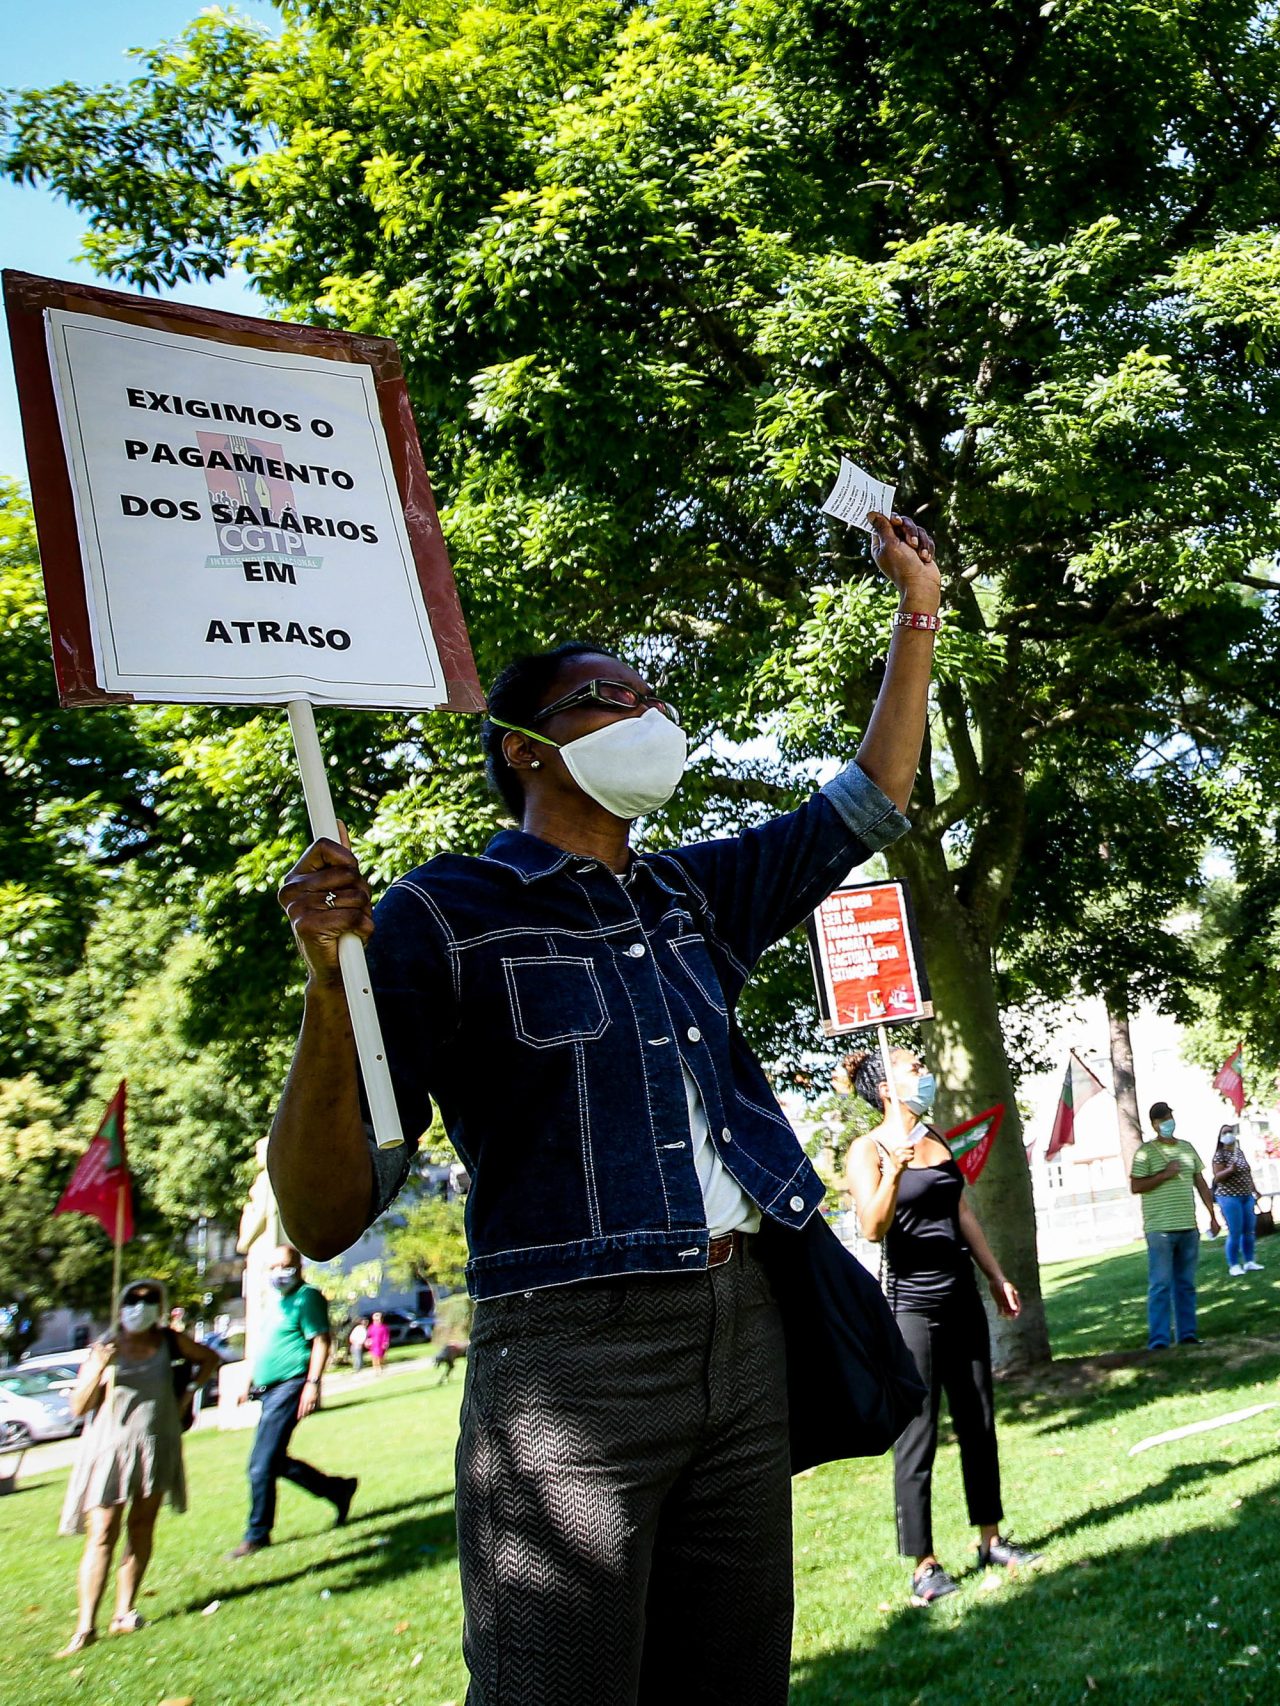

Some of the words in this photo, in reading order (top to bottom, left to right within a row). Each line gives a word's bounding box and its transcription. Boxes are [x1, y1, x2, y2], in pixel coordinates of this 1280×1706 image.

[126, 387, 302, 433] EXIGIMOS
[311, 418, 335, 439] O
[124, 439, 355, 490] PAGAMENTO
[120, 494, 202, 522] DOS
[212, 503, 379, 544] SALÁRIOS
[220, 525, 302, 554] CGTP
[244, 561, 297, 585] EM
[205, 619, 352, 652] ATRASO
